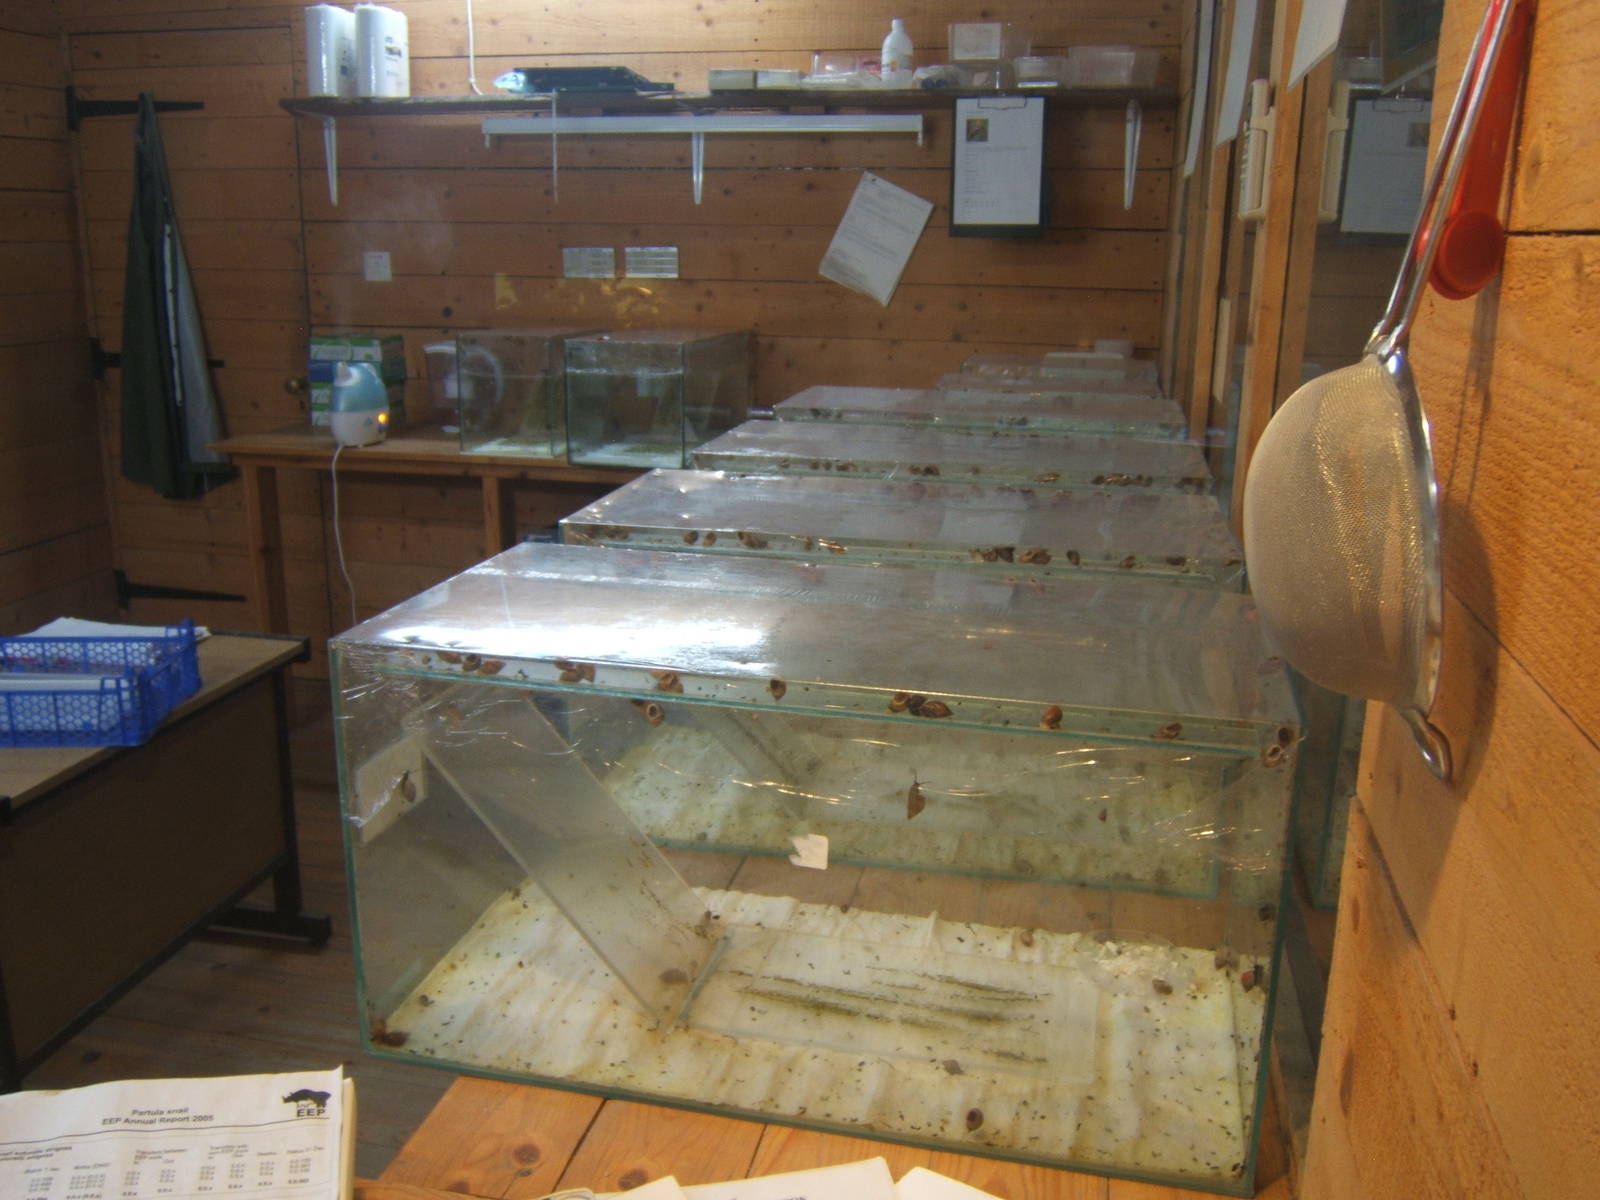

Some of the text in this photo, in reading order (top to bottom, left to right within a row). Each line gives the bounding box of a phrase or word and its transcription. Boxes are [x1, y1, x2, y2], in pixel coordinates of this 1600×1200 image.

[296, 1108, 327, 1118] EEP
[102, 1116, 122, 1126] EEP
[123, 1116, 157, 1125] Annual
[159, 1115, 190, 1125] Report
